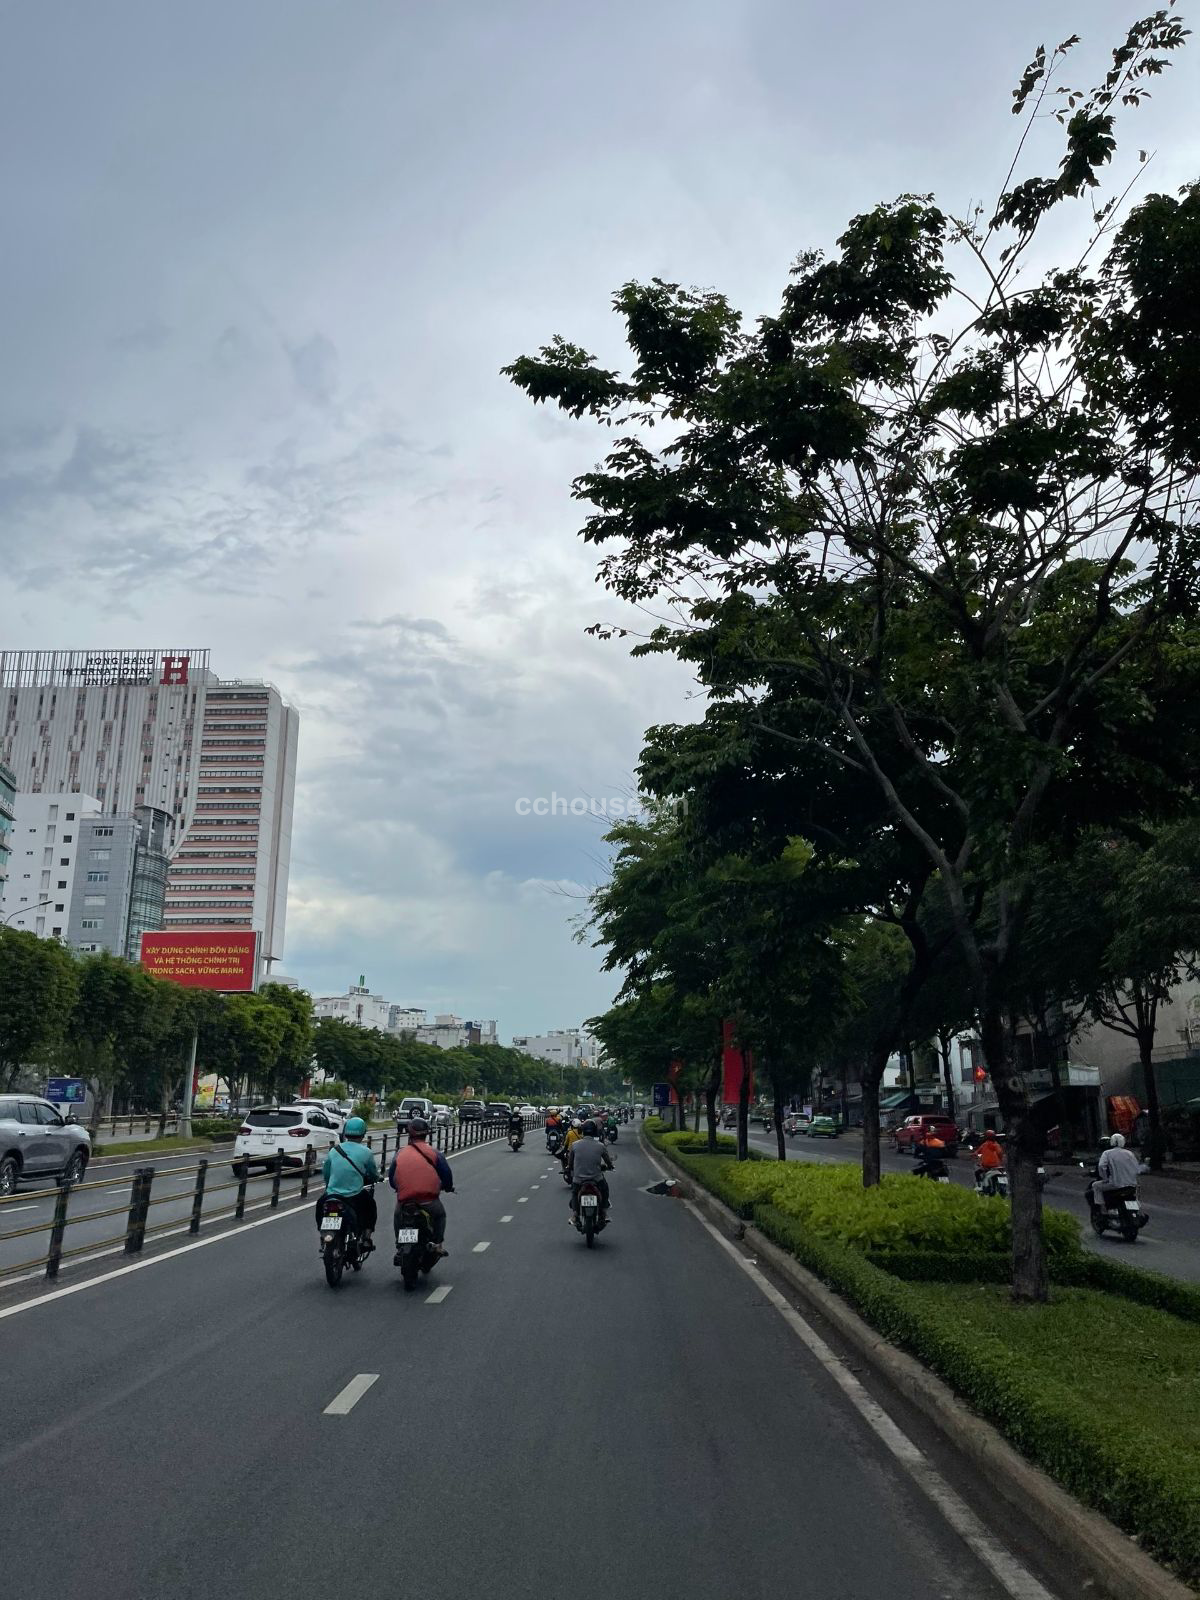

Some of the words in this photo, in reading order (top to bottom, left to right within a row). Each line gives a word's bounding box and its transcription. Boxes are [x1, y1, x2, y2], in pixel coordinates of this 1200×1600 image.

[86, 657, 119, 665] HONG
[123, 656, 154, 665] BANG
[63, 668, 153, 676] INTERNATIONAL
[160, 656, 190, 685] H
[84, 677, 152, 686] UNIVERSITY
